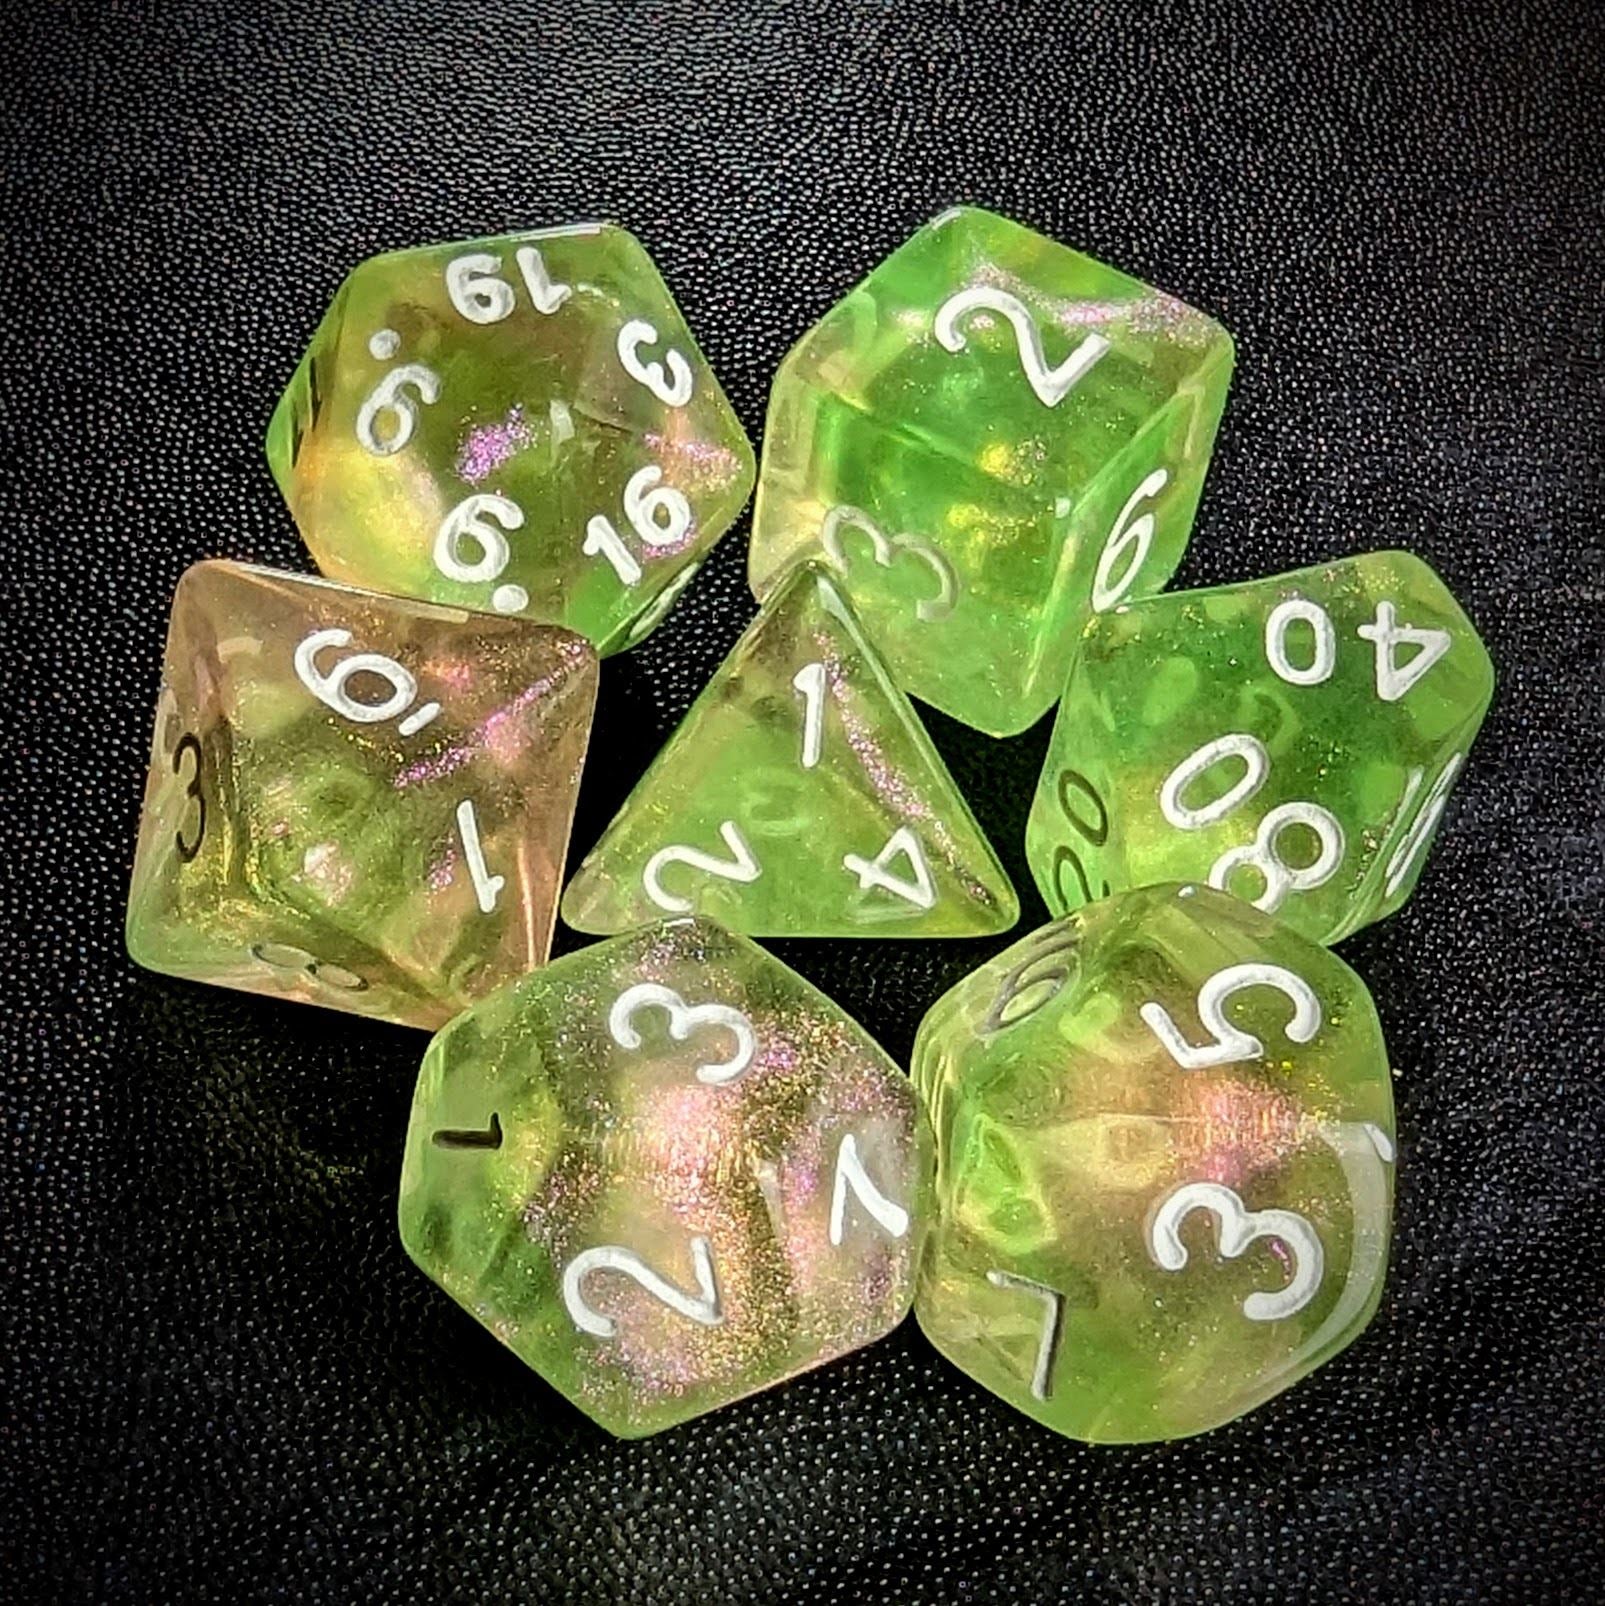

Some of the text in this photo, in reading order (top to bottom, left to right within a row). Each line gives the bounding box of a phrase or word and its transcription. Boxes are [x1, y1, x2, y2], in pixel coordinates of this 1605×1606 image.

[617, 320, 693, 407] 3
[935, 286, 1110, 407] 2
[583, 466, 692, 586] 16
[822, 505, 960, 623] 3
[1266, 600, 1451, 701] 40
[793, 663, 826, 768] 1
[172, 732, 207, 863] 3
[456, 800, 505, 914] 1
[643, 820, 762, 912] 2
[843, 827, 936, 909] 4
[609, 983, 757, 1084] 3
[1140, 963, 1323, 1070] 5
[431, 1112, 503, 1150] 1
[563, 1237, 724, 1337] 2
[1150, 1182, 1325, 1321] 3
[986, 1269, 1066, 1401] 7
